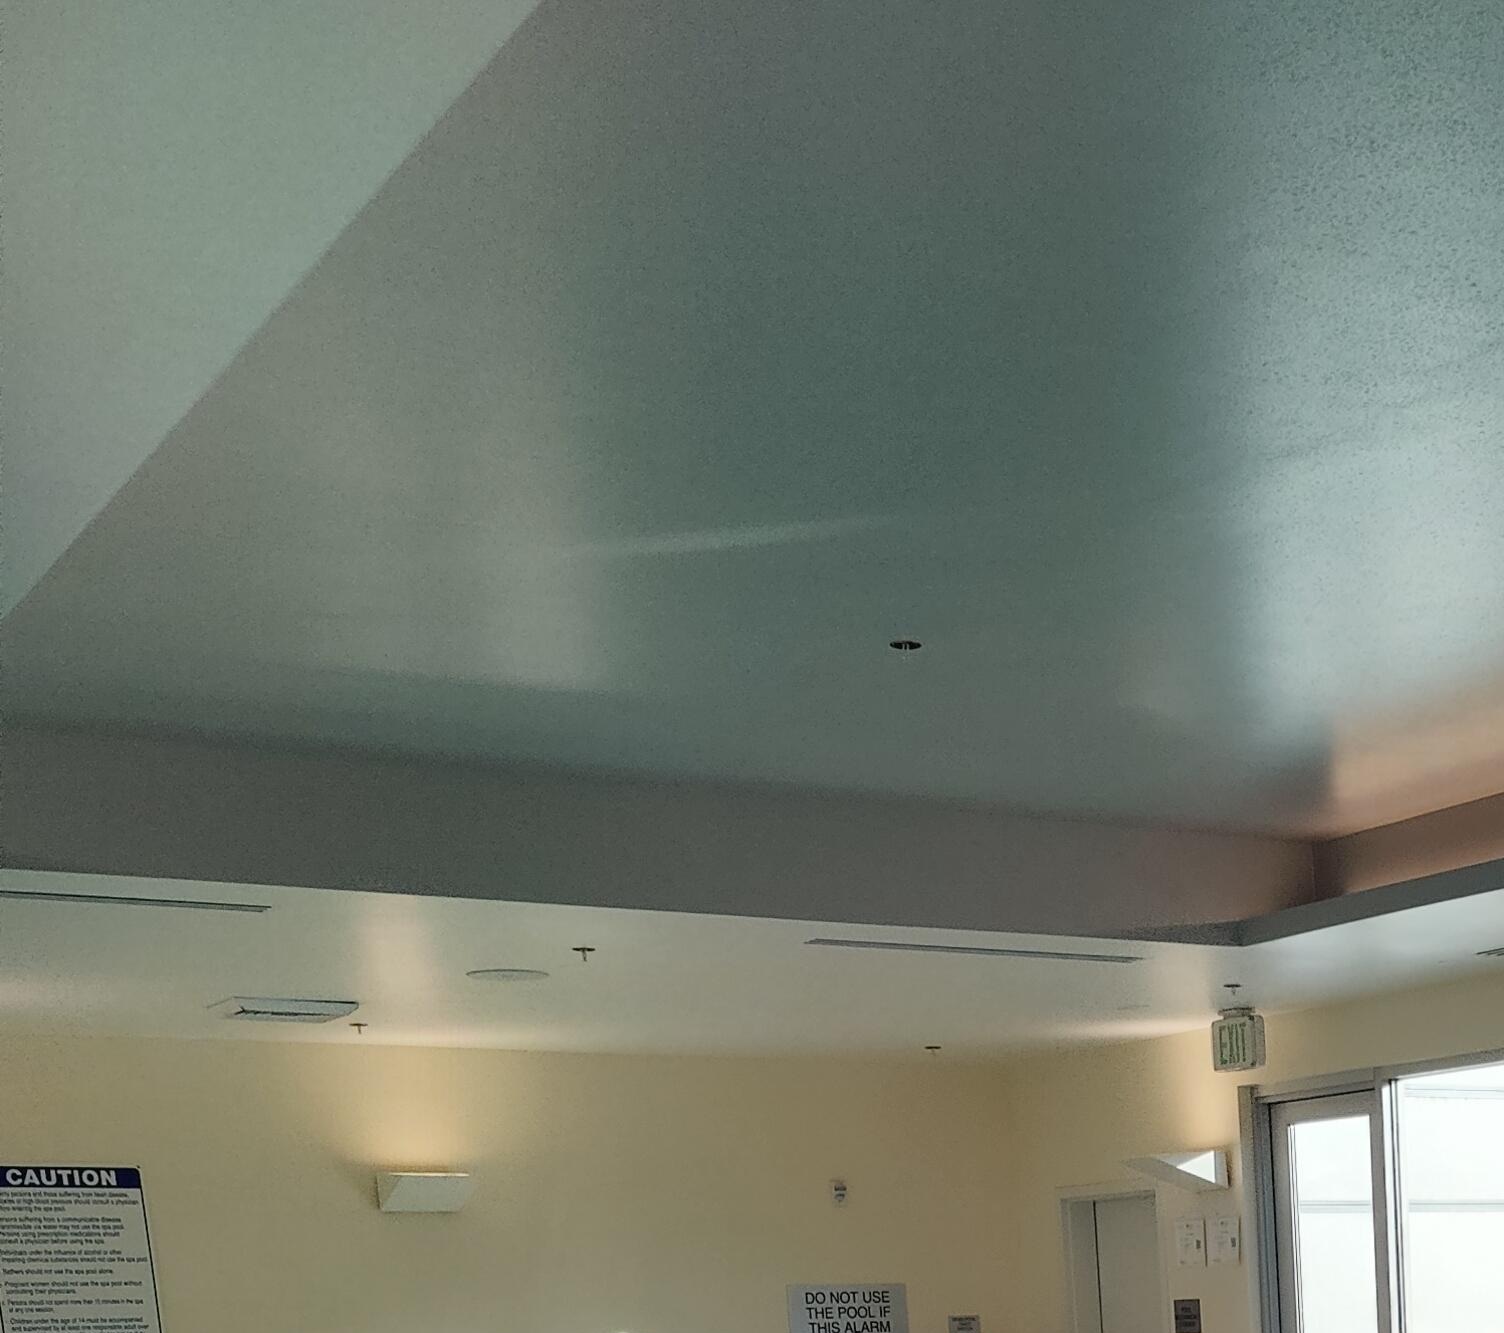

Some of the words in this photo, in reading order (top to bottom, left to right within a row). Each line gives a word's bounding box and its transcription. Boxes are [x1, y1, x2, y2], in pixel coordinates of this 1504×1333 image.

[1219, 1022, 1247, 1065] EXIT
[5, 1168, 118, 1186] CAUTION
[805, 1292, 826, 1304] DO
[830, 1291, 859, 1304] NOT
[862, 1290, 890, 1304] USE
[806, 1306, 834, 1319] THE
[838, 1306, 876, 1319] POOL
[879, 1305, 891, 1318] IF
[808, 1321, 840, 1333] THIS
[844, 1321, 891, 1333] ALARM
